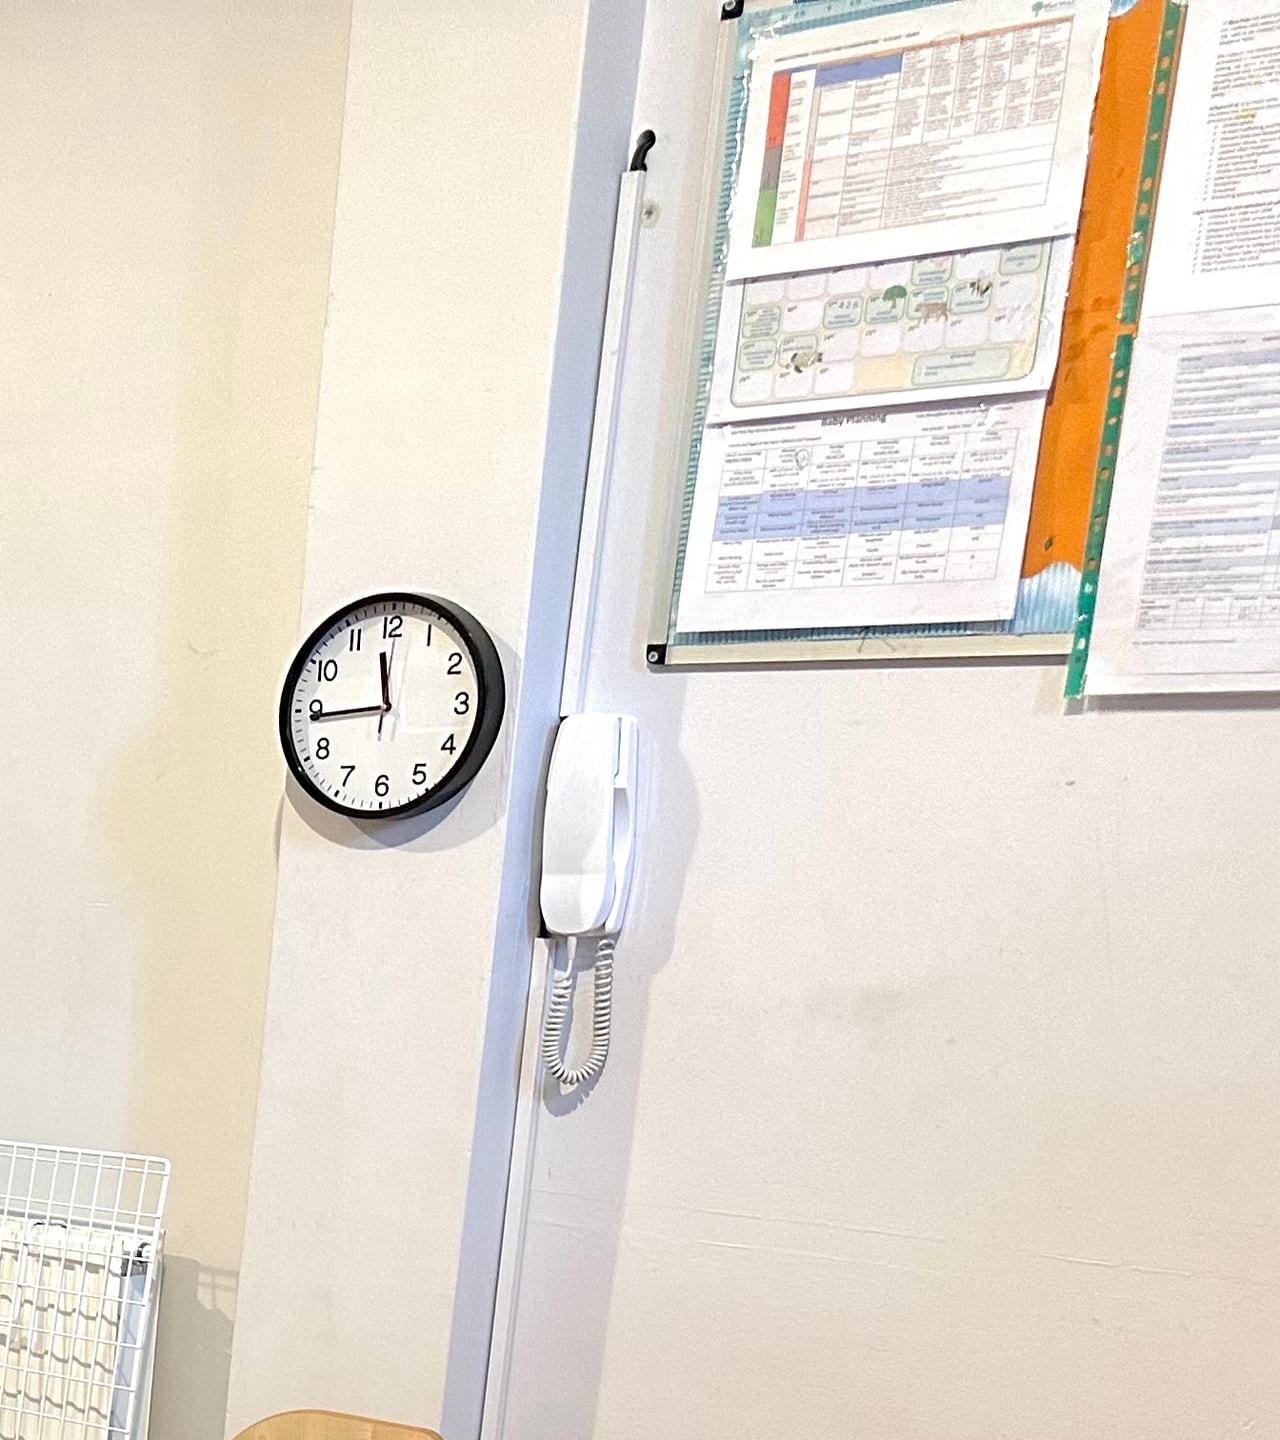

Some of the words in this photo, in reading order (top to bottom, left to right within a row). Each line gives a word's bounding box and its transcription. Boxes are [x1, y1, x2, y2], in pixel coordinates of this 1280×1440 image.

[383, 616, 403, 639] 12
[427, 624, 432, 647] 1
[349, 629, 362, 651] 11
[317, 659, 338, 682] 10
[447, 653, 463, 675] 2
[309, 699, 323, 720] 9
[453, 691, 470, 715] 3
[316, 737, 330, 760] 8
[441, 733, 456, 755] 4
[340, 765, 356, 787] 7
[412, 763, 427, 785] 5
[375, 775, 389, 797] 6
